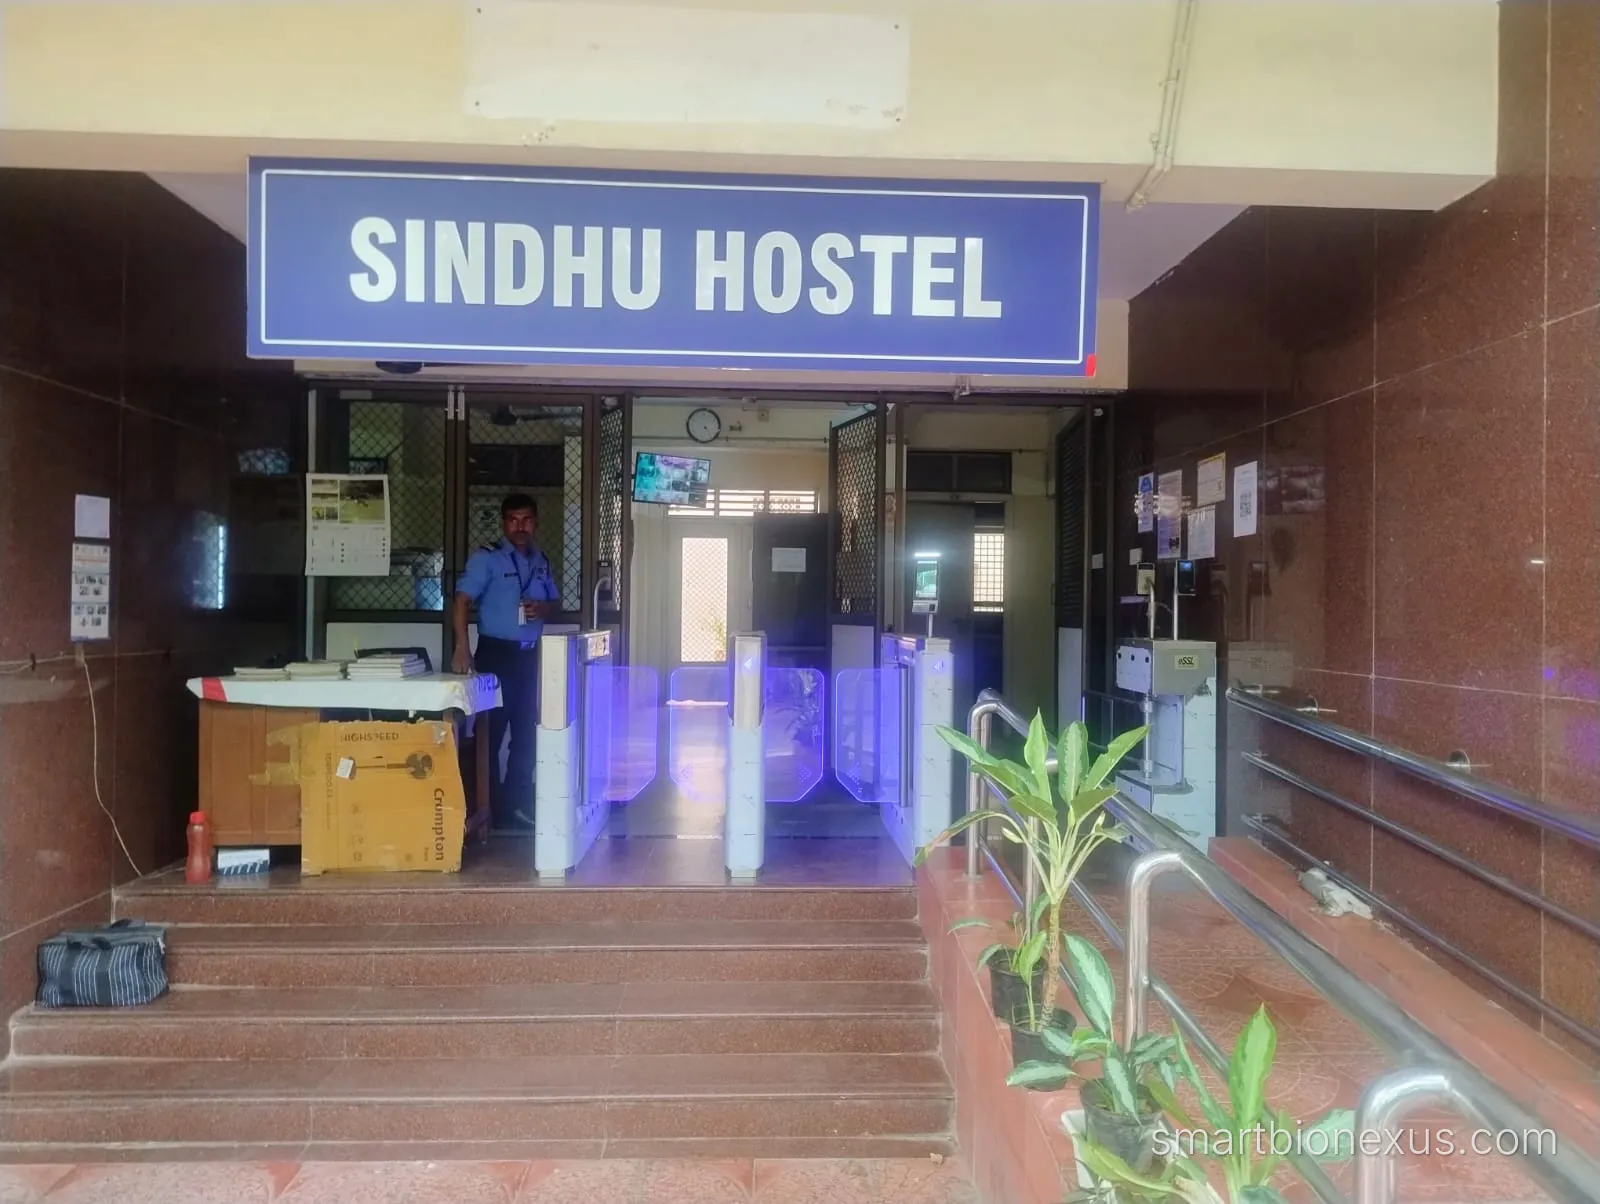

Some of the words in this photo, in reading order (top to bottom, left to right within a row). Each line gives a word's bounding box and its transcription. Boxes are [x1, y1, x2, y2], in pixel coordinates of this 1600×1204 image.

[349, 216, 661, 310] SINDHU
[695, 229, 1001, 318] HOSTEL
[432, 788, 445, 861] Crompton
